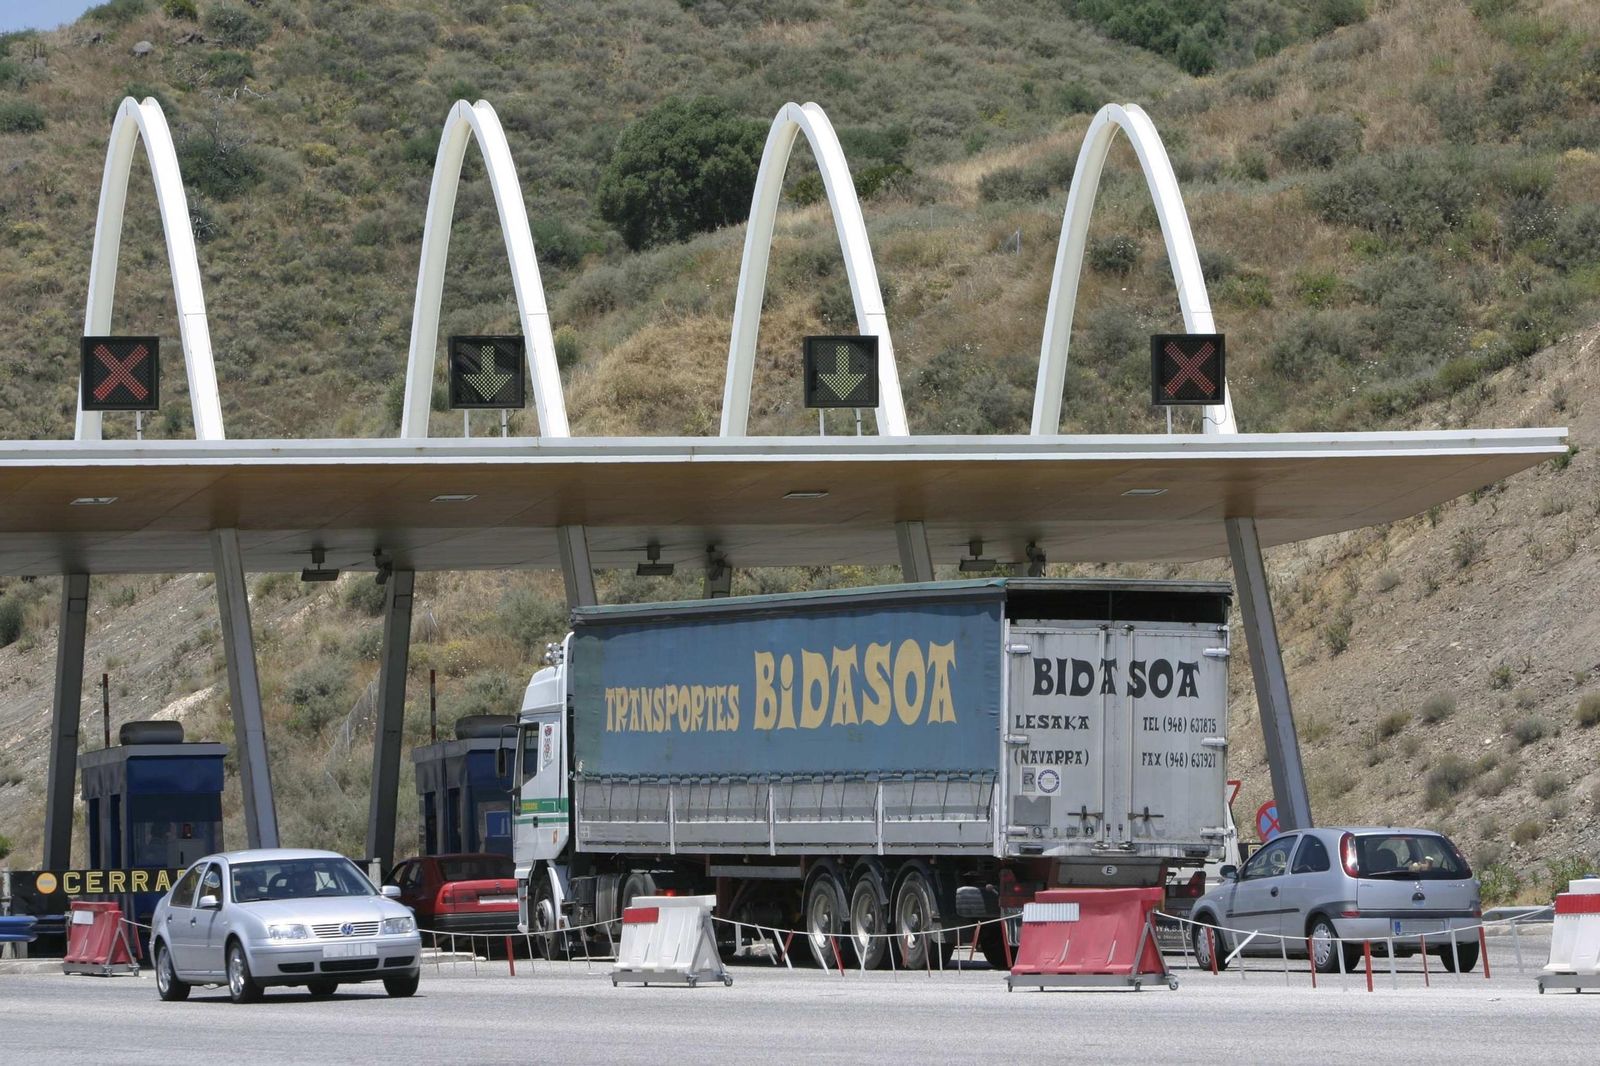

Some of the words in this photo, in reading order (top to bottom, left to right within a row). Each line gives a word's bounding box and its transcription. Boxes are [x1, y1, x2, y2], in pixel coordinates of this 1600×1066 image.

[605, 684, 739, 733] TRANSPORTES
[1015, 715, 1090, 730] LESAKA
[1143, 717, 1159, 731] TEL
[1163, 715, 1187, 733] (948)
[1190, 718, 1217, 733] 637875
[1014, 749, 1089, 766] (NAVARRA)
[1142, 752, 1161, 766] FAX
[1165, 751, 1188, 768] (948)
[63, 870, 186, 893] CERRA
